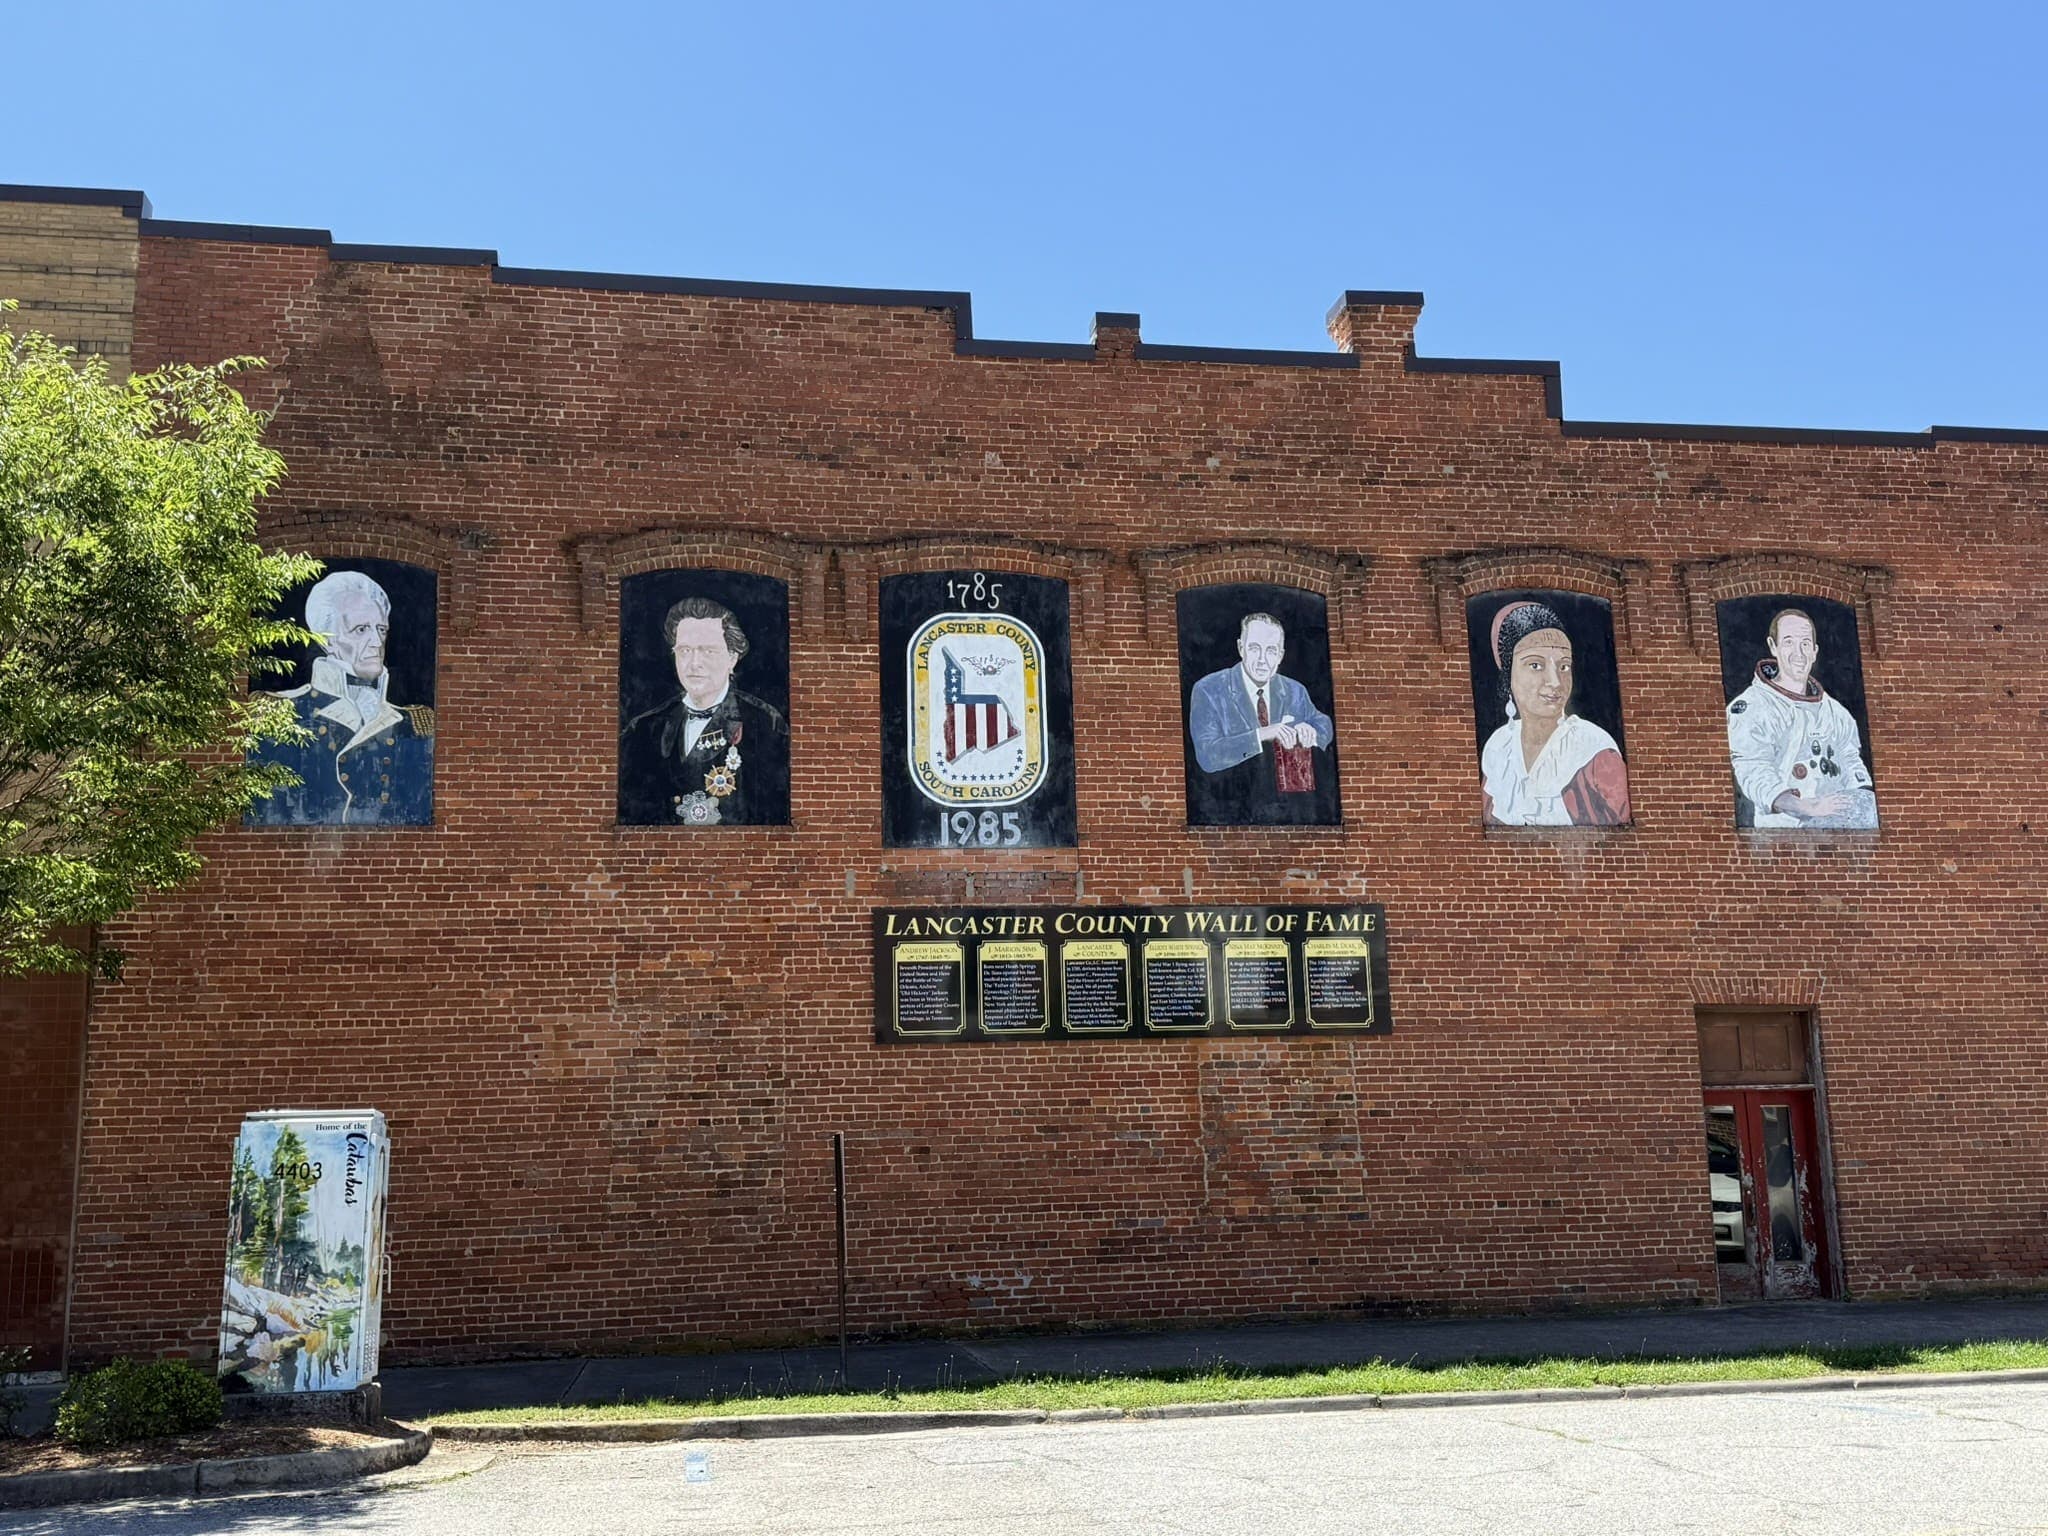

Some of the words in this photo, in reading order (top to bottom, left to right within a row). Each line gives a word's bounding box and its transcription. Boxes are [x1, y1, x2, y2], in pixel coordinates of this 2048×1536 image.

[947, 572, 1003, 610] 1785
[917, 623, 987, 671] LANCASTER
[996, 624, 1036, 671] COUNTY
[919, 762, 964, 798] SOUTH
[970, 761, 1039, 798] CAROLINA
[940, 810, 1022, 846] 1985
[885, 914, 1046, 936] LANCASTER
[1054, 912, 1176, 935] COUNTY
[1184, 911, 1258, 933] WALL
[1265, 914, 1298, 932] OF
[1304, 911, 1376, 932] FAME
[315, 1123, 341, 1131] Home
[354, 1122, 367, 1130] the
[274, 1162, 322, 1180] 4403
[345, 1133, 368, 1206] Catawbas
